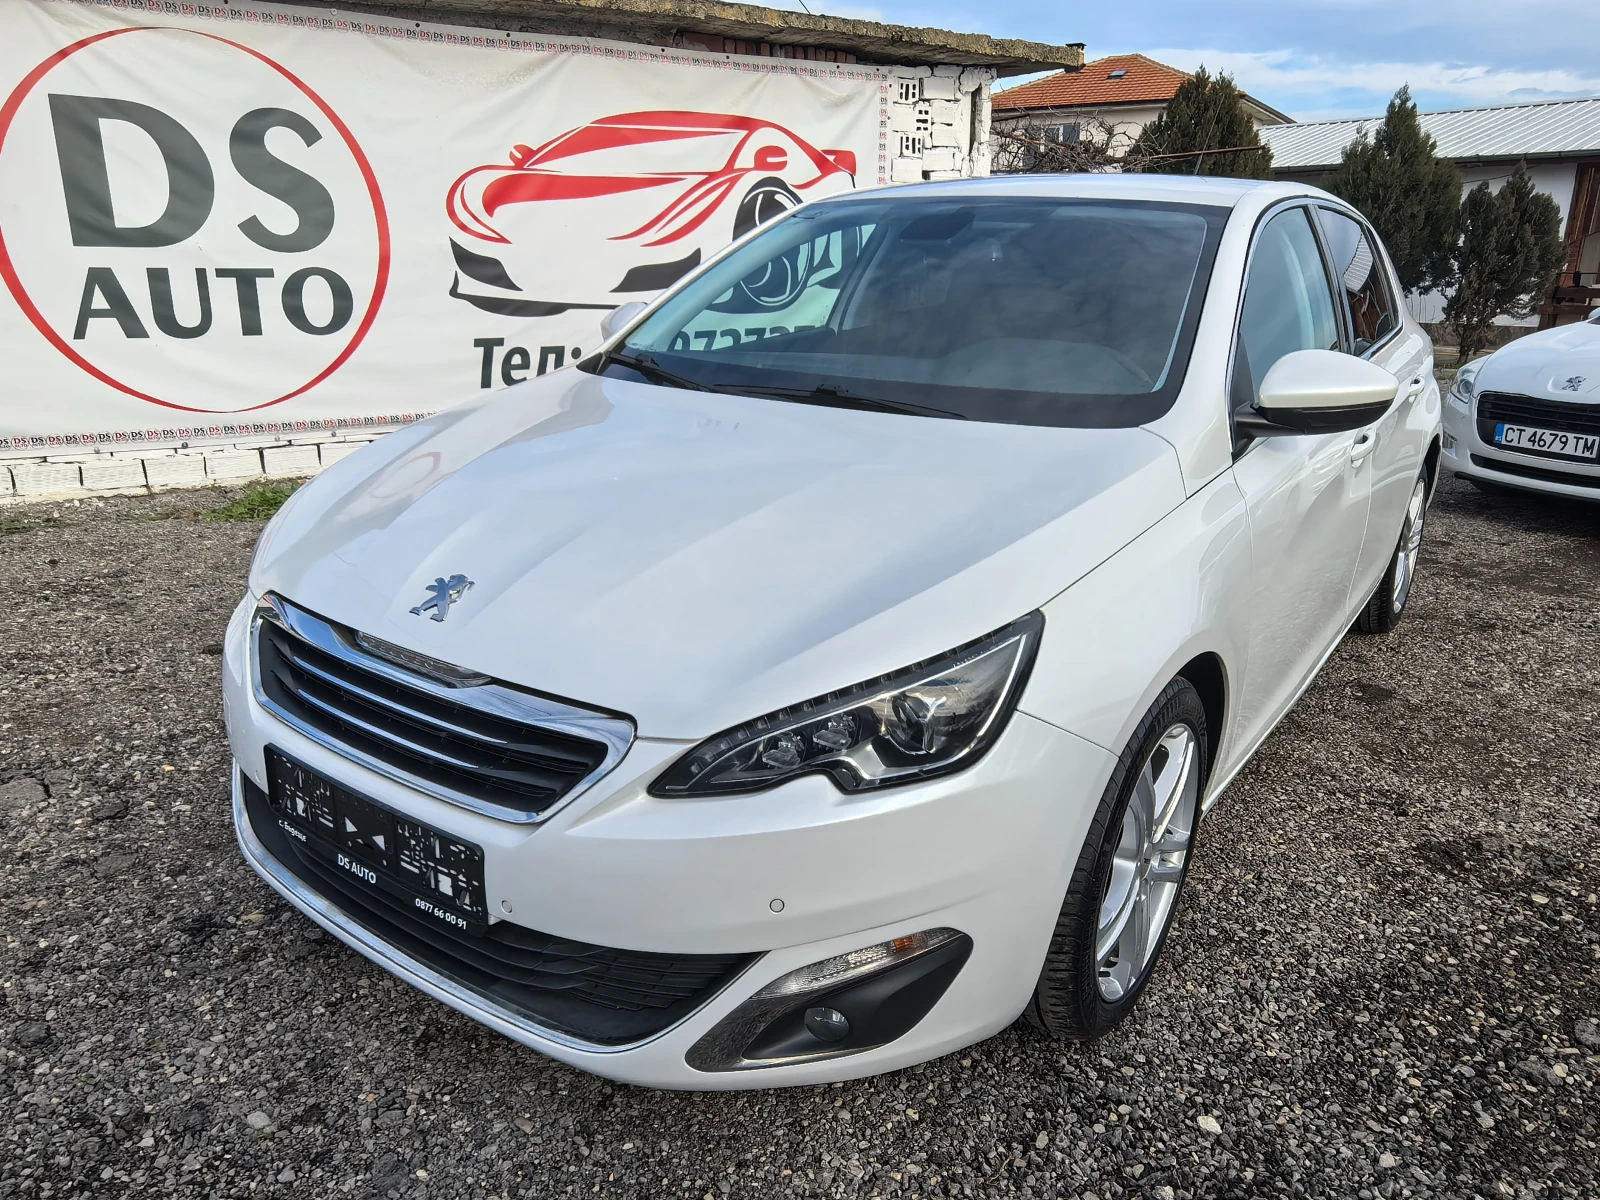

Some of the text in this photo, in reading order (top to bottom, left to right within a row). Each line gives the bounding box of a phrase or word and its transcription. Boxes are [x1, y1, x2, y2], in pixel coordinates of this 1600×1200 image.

[48, 94, 335, 253] DS
[73, 267, 354, 340] AUTO
[1504, 427, 1597, 456] CT 4679 TM
[338, 854, 377, 884] DS AUTO
[415, 898, 467, 930] 0877 66 00 91
